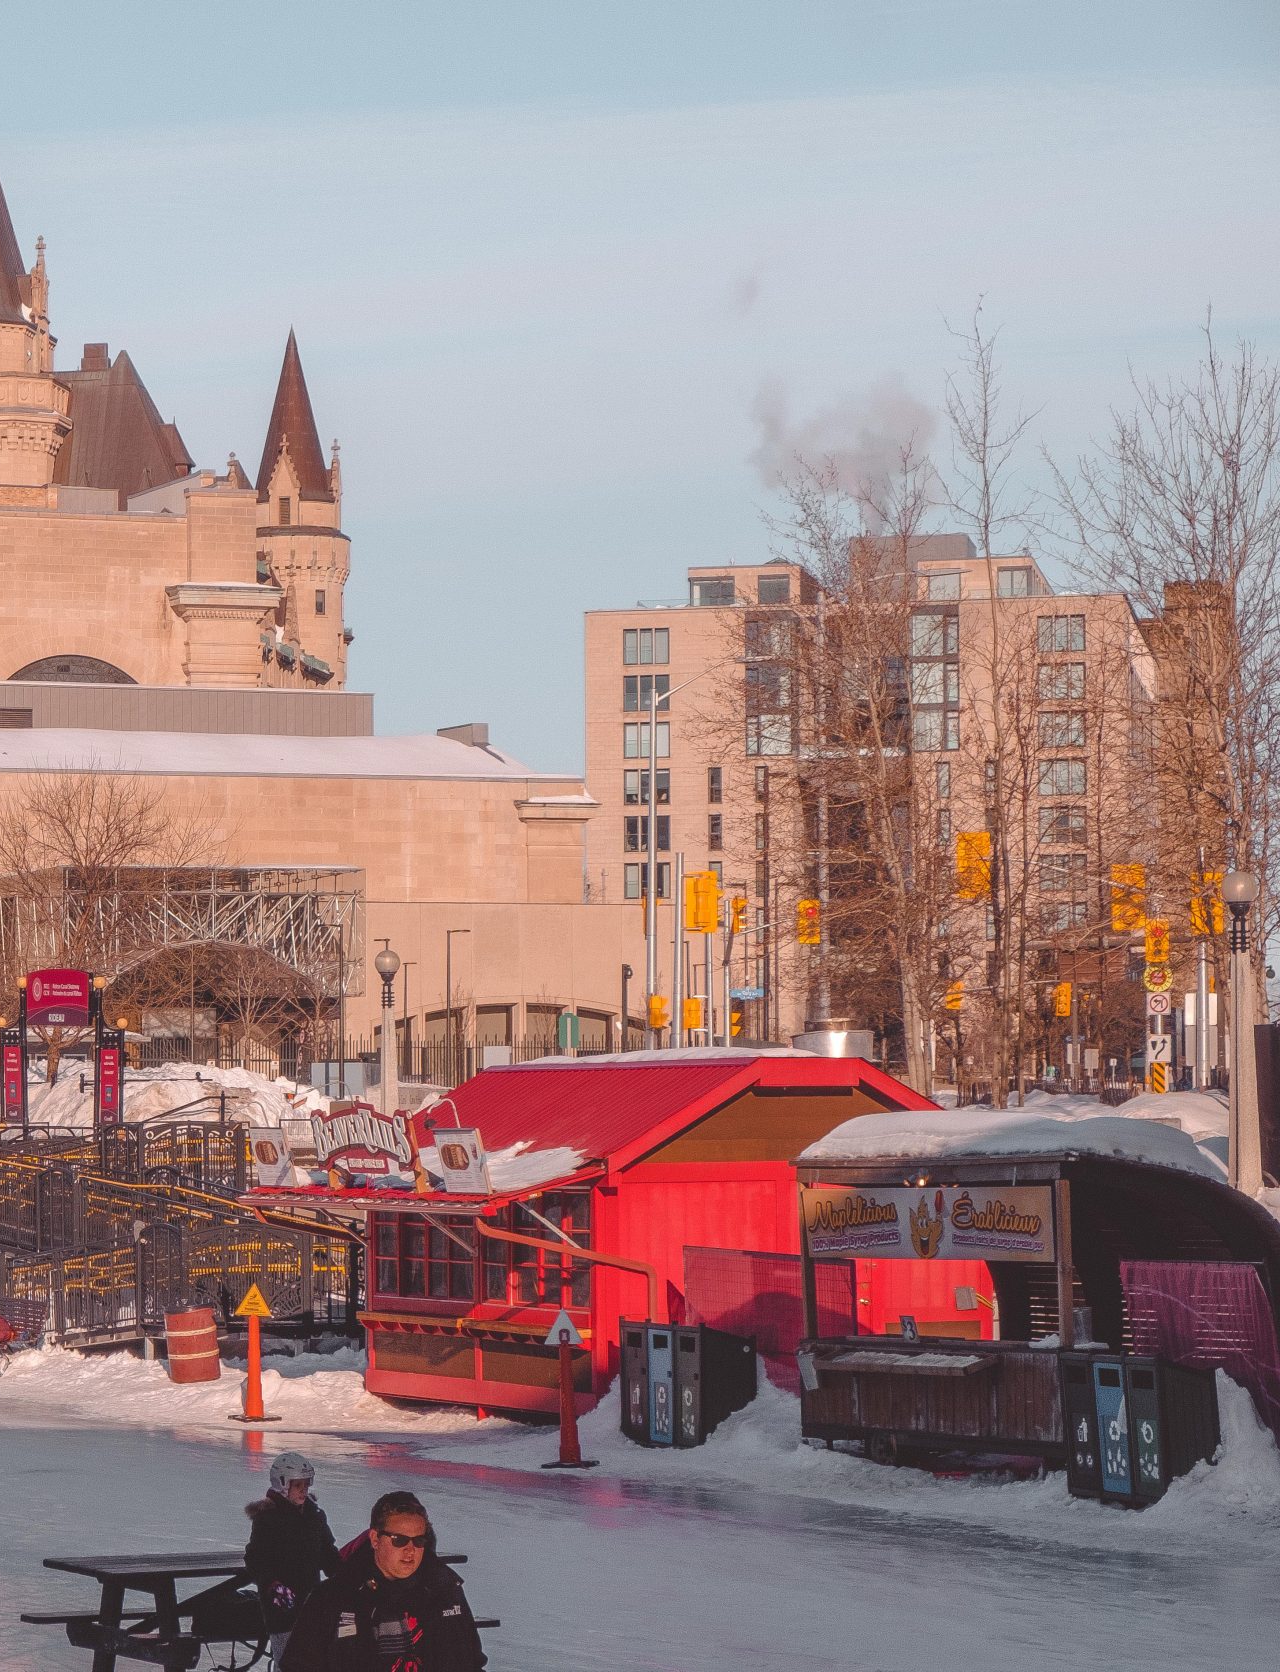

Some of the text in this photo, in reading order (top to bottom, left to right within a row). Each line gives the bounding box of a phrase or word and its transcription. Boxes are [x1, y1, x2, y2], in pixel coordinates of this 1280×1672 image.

[49, 1014, 64, 1022] RIDEAU
[809, 1191, 1041, 1236] Maplelicious Érablicieux
[813, 1230, 899, 1251] 100% Maple Syrup Products
